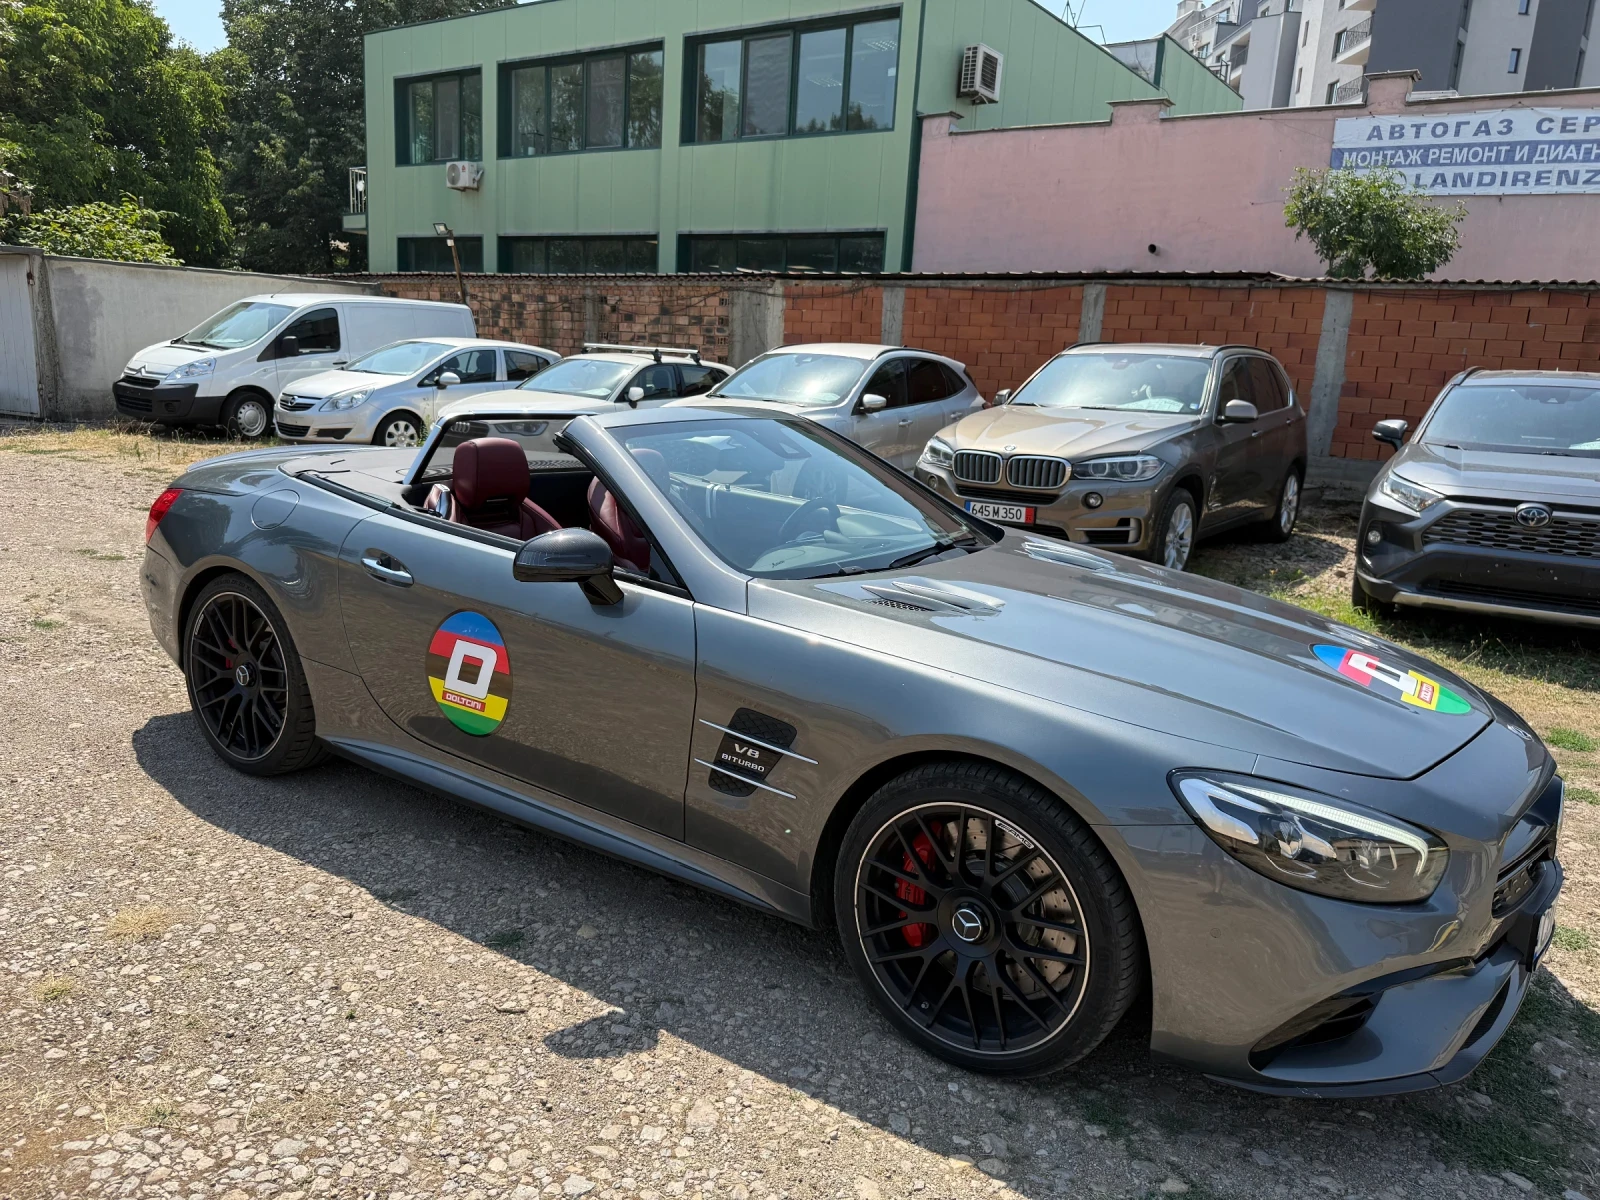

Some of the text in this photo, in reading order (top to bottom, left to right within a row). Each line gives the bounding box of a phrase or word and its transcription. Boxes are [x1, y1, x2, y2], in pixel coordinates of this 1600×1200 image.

[1366, 116, 1600, 141] АВТОГАЗ СЕР
[1342, 148, 1424, 167] МОНТАЖ
[1428, 145, 1510, 164] РЕМОНТ
[1514, 145, 1529, 161] И
[445, 693, 482, 709] DOLTCINI
[734, 743, 760, 758] V8
[721, 753, 765, 772] BITURBO
